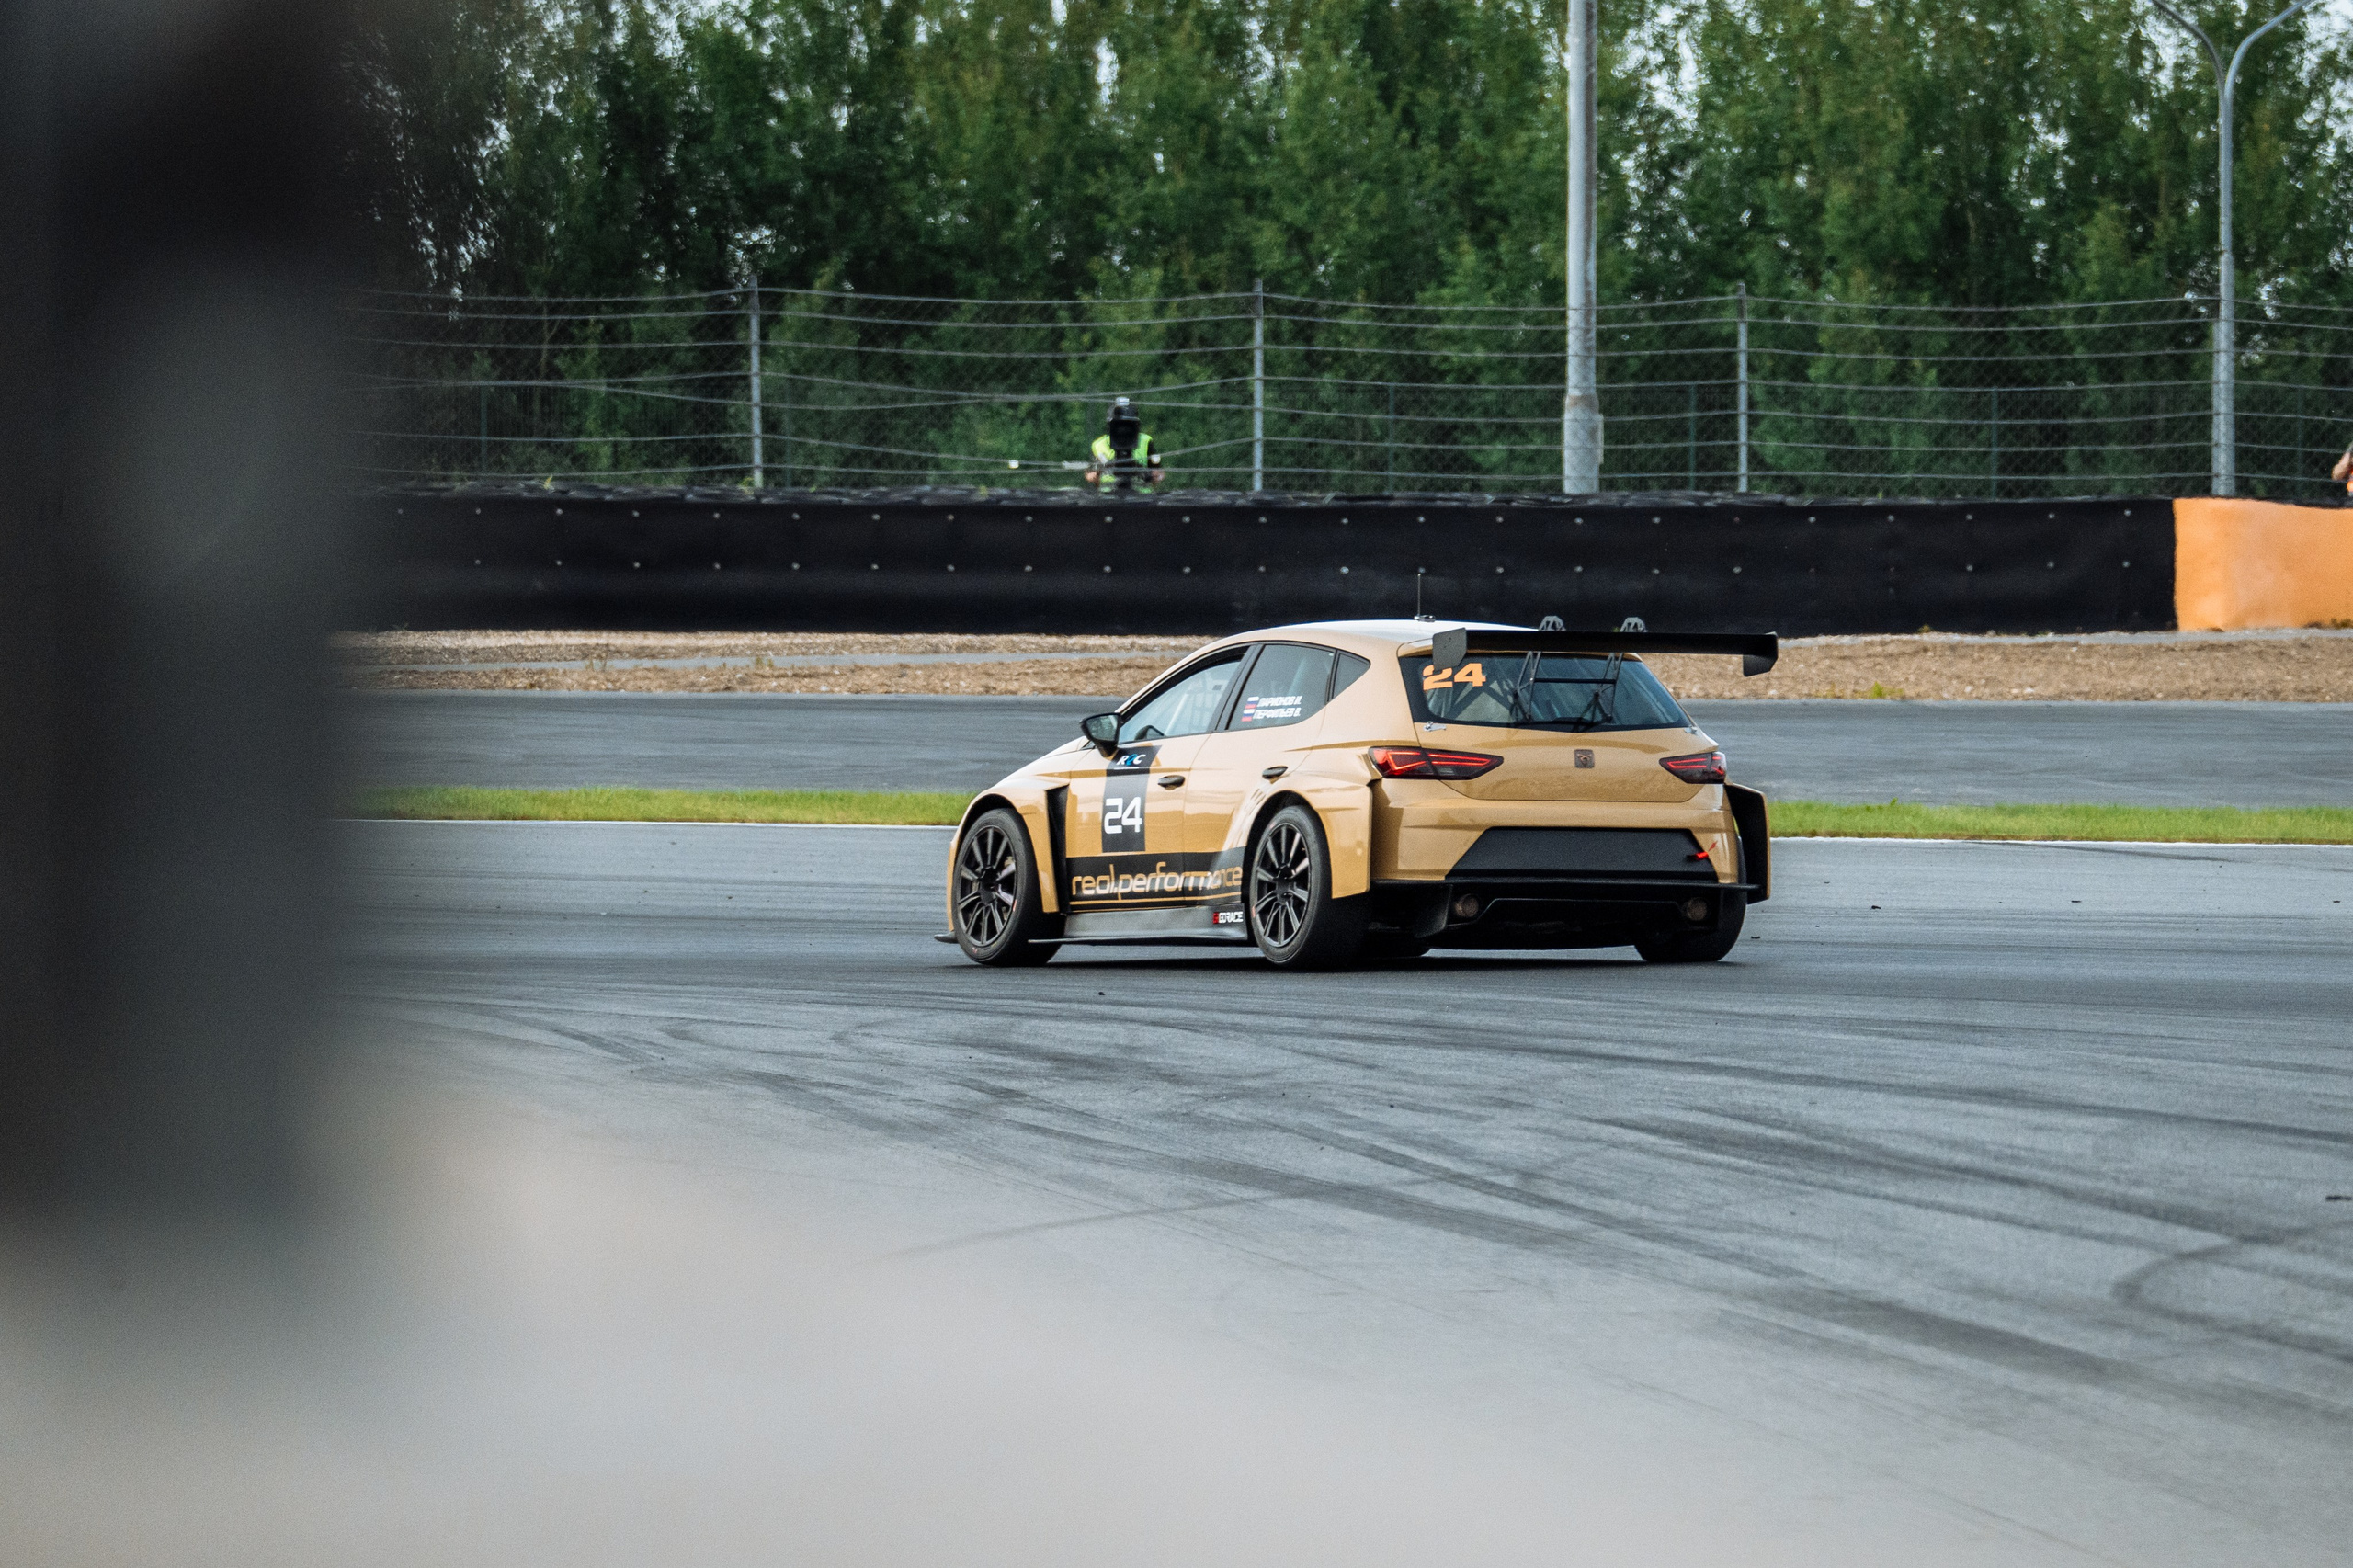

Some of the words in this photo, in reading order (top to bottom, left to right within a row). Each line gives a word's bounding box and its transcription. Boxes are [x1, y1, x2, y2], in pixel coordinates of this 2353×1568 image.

[1422, 663, 1486, 691] 24
[1104, 796, 1143, 835] 24
[1072, 861, 1244, 901] real.performance
